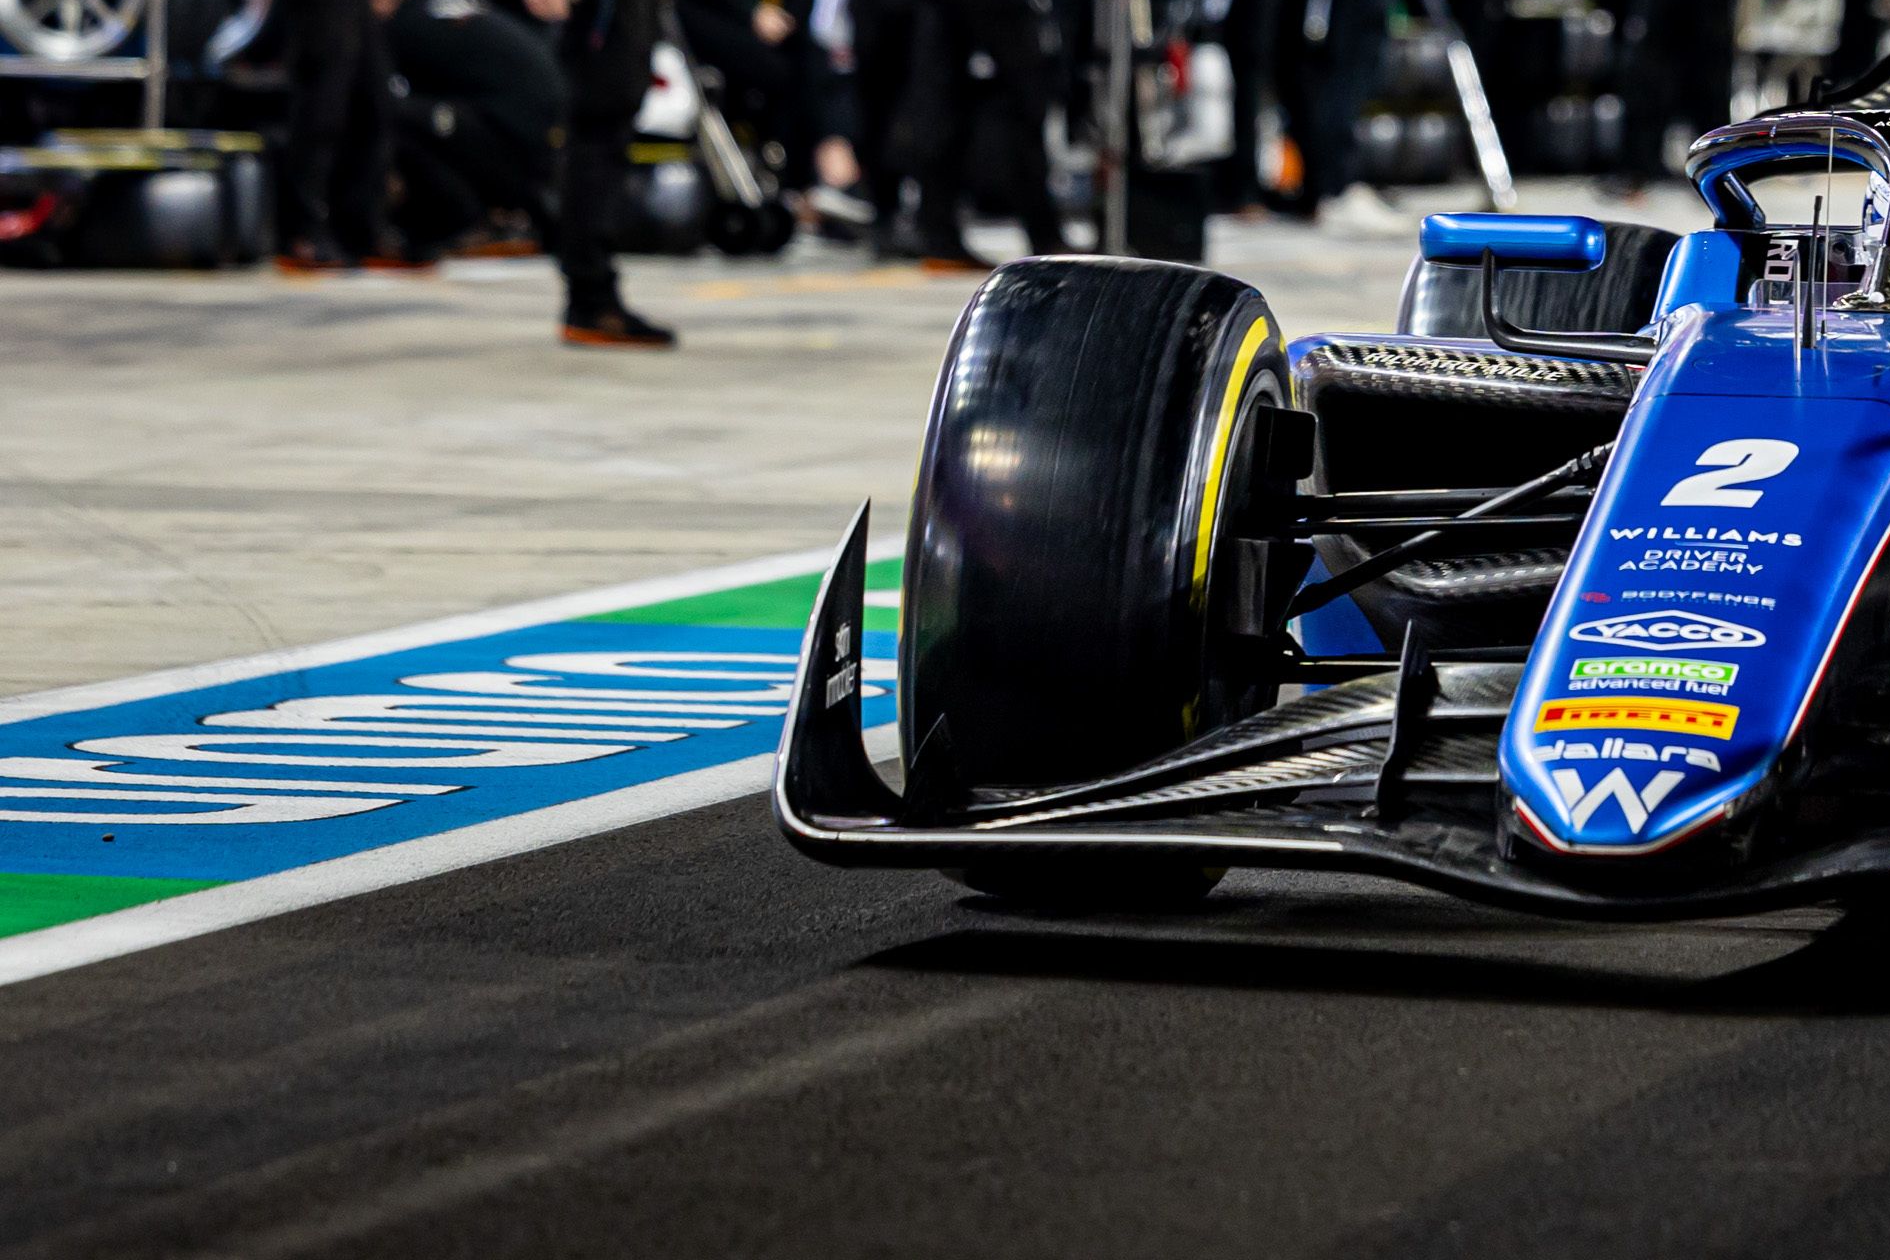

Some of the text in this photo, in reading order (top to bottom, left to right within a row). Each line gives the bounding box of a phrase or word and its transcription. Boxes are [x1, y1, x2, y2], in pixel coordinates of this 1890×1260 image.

[1764, 233, 1799, 281] RD
[1660, 438, 1800, 508] 2
[1609, 526, 1803, 547] WILLIAMS
[1643, 549, 1748, 563] DRIVER
[1618, 560, 1764, 575] ACADEMY
[1595, 622, 1744, 643] YACCO
[1582, 660, 1727, 680] aramco
[1568, 677, 1729, 697] advanced fuel
[1531, 736, 1722, 773] dallara
